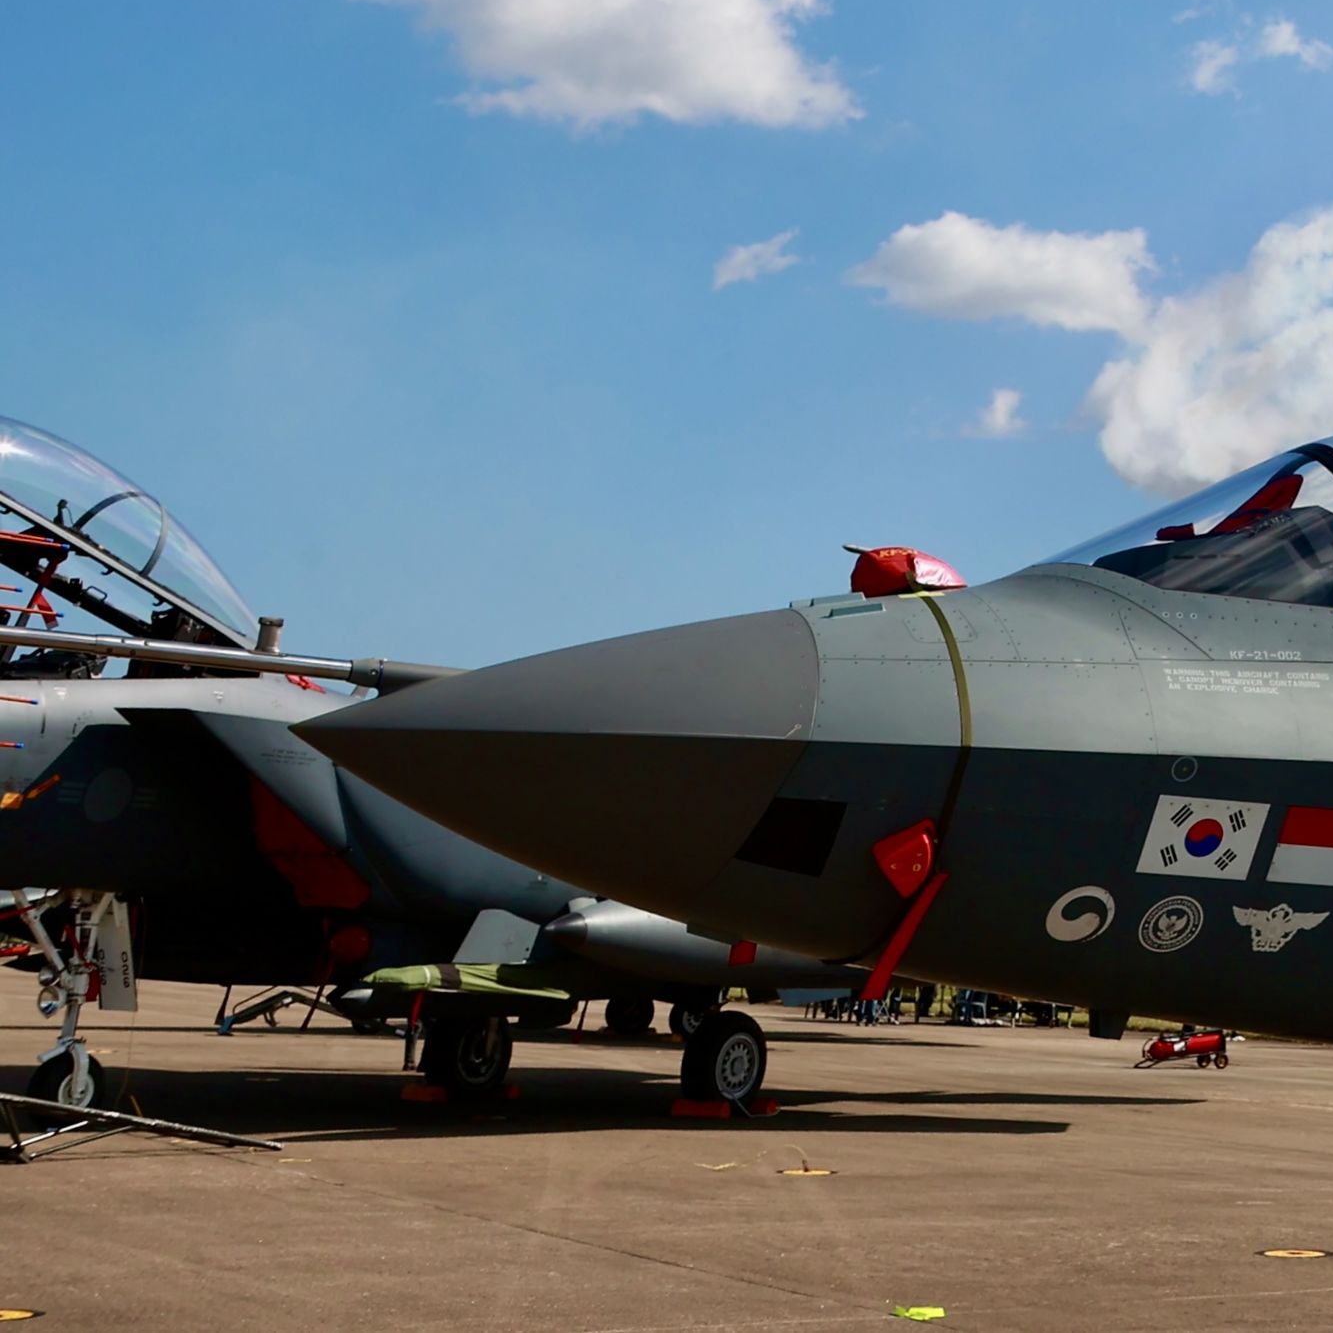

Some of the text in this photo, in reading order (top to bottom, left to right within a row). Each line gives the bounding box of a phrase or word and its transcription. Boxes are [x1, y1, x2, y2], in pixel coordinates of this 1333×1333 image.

[1229, 650, 1301, 661] KF-21-002
[1237, 670, 1279, 679] AIRCRAFT
[1286, 672, 1330, 681] CONTAINS
[1179, 676, 1214, 684] CANOPY
[1269, 679, 1321, 688] CONTAINING
[1187, 684, 1238, 693] EXPLOSIVE
[1243, 686, 1279, 695] CHARGE
[121, 951, 130, 988] 026
